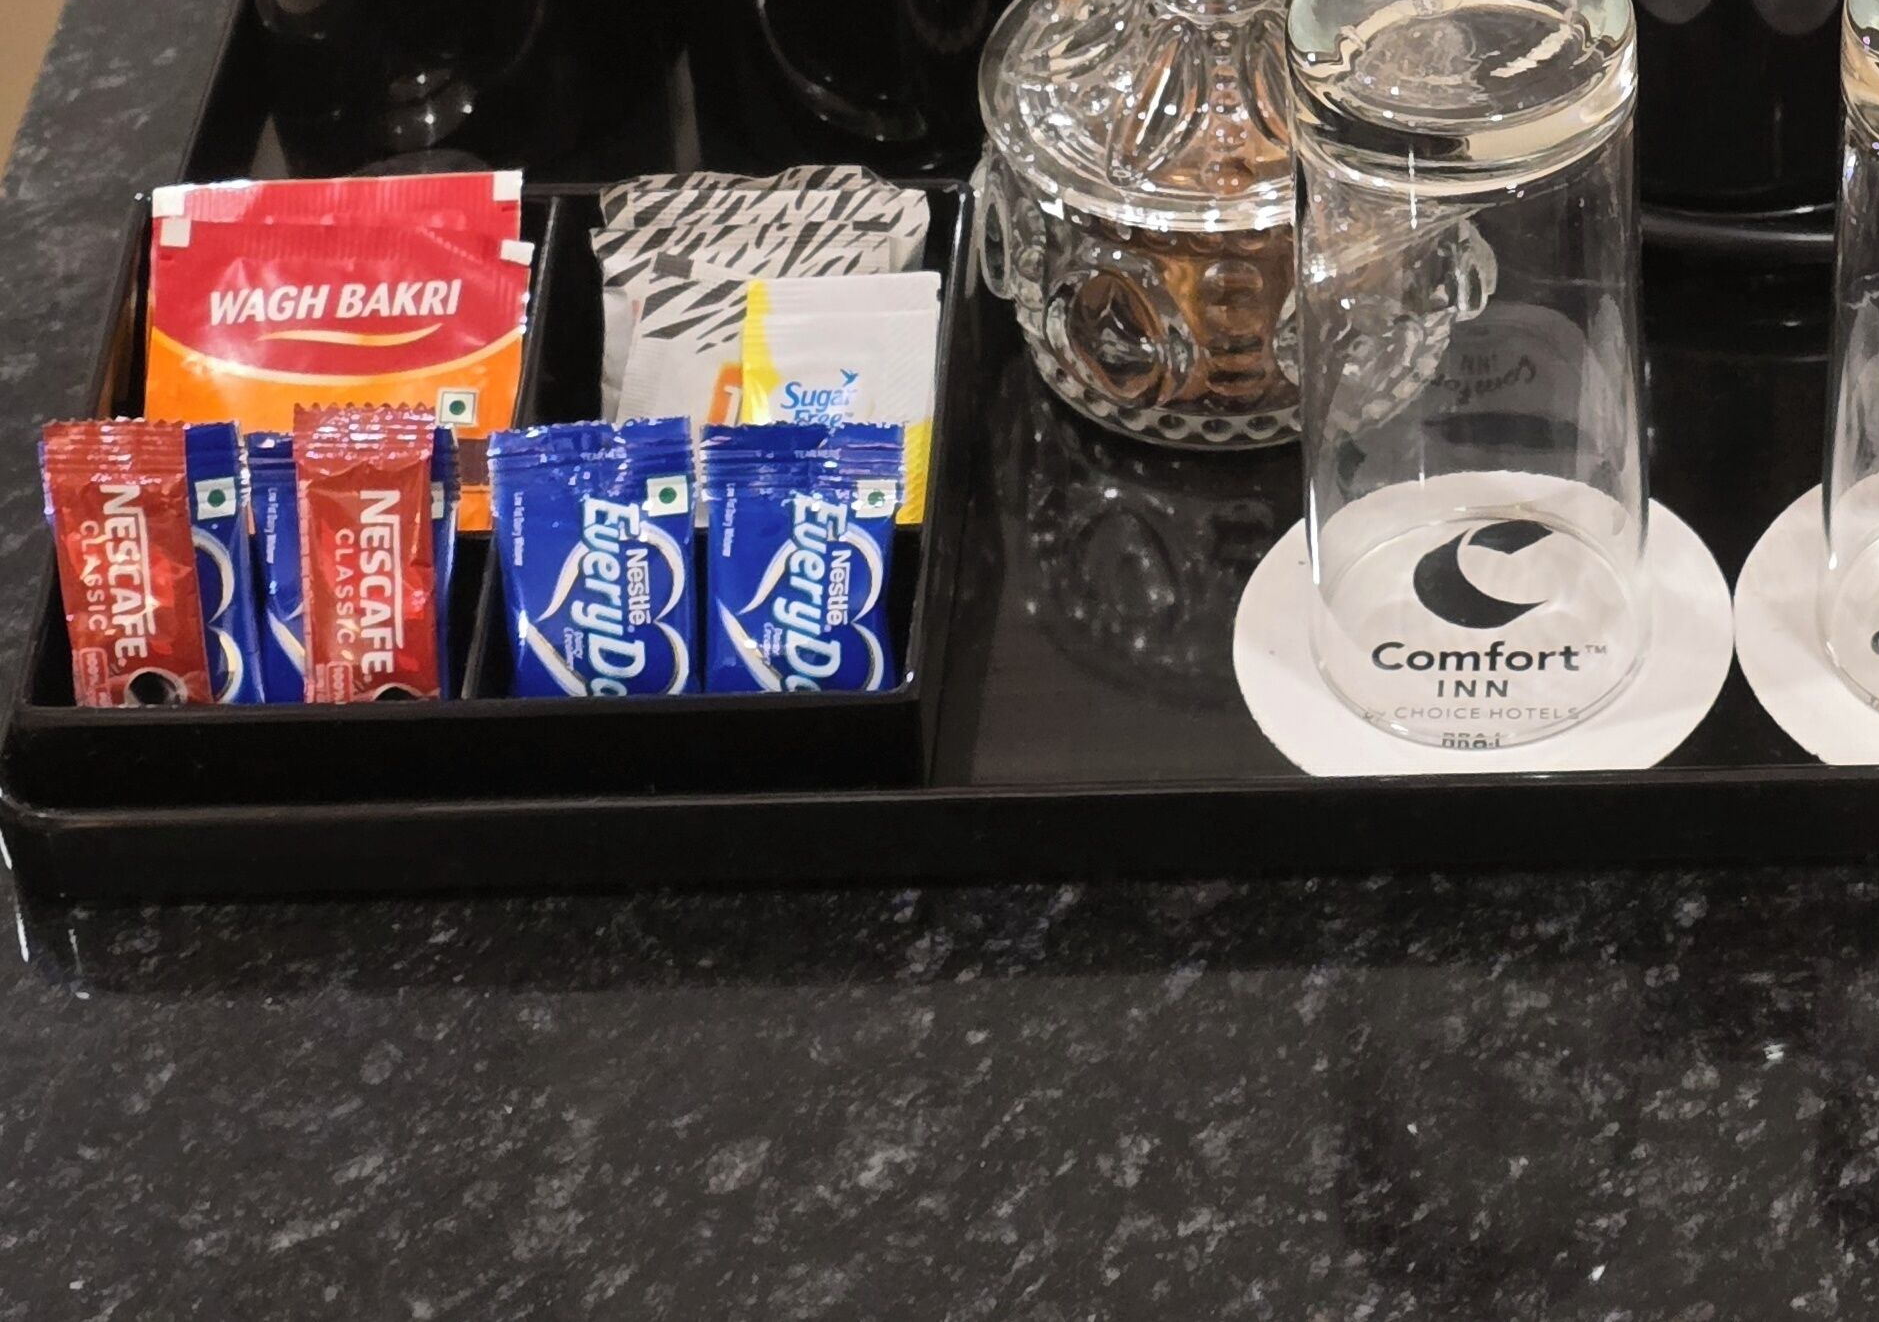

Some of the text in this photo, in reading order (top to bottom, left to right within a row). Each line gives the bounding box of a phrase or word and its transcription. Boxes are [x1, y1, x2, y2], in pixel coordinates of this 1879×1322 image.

[210, 278, 462, 326] WAGH BAKRI
[780, 380, 855, 413] Sugar
[80, 520, 108, 632] CLASSIC
[335, 527, 356, 645] CLASSIC
[1437, 679, 1509, 697] INN
[1394, 707, 1481, 720] CHOICE
[1489, 707, 1580, 720] HOTELS
